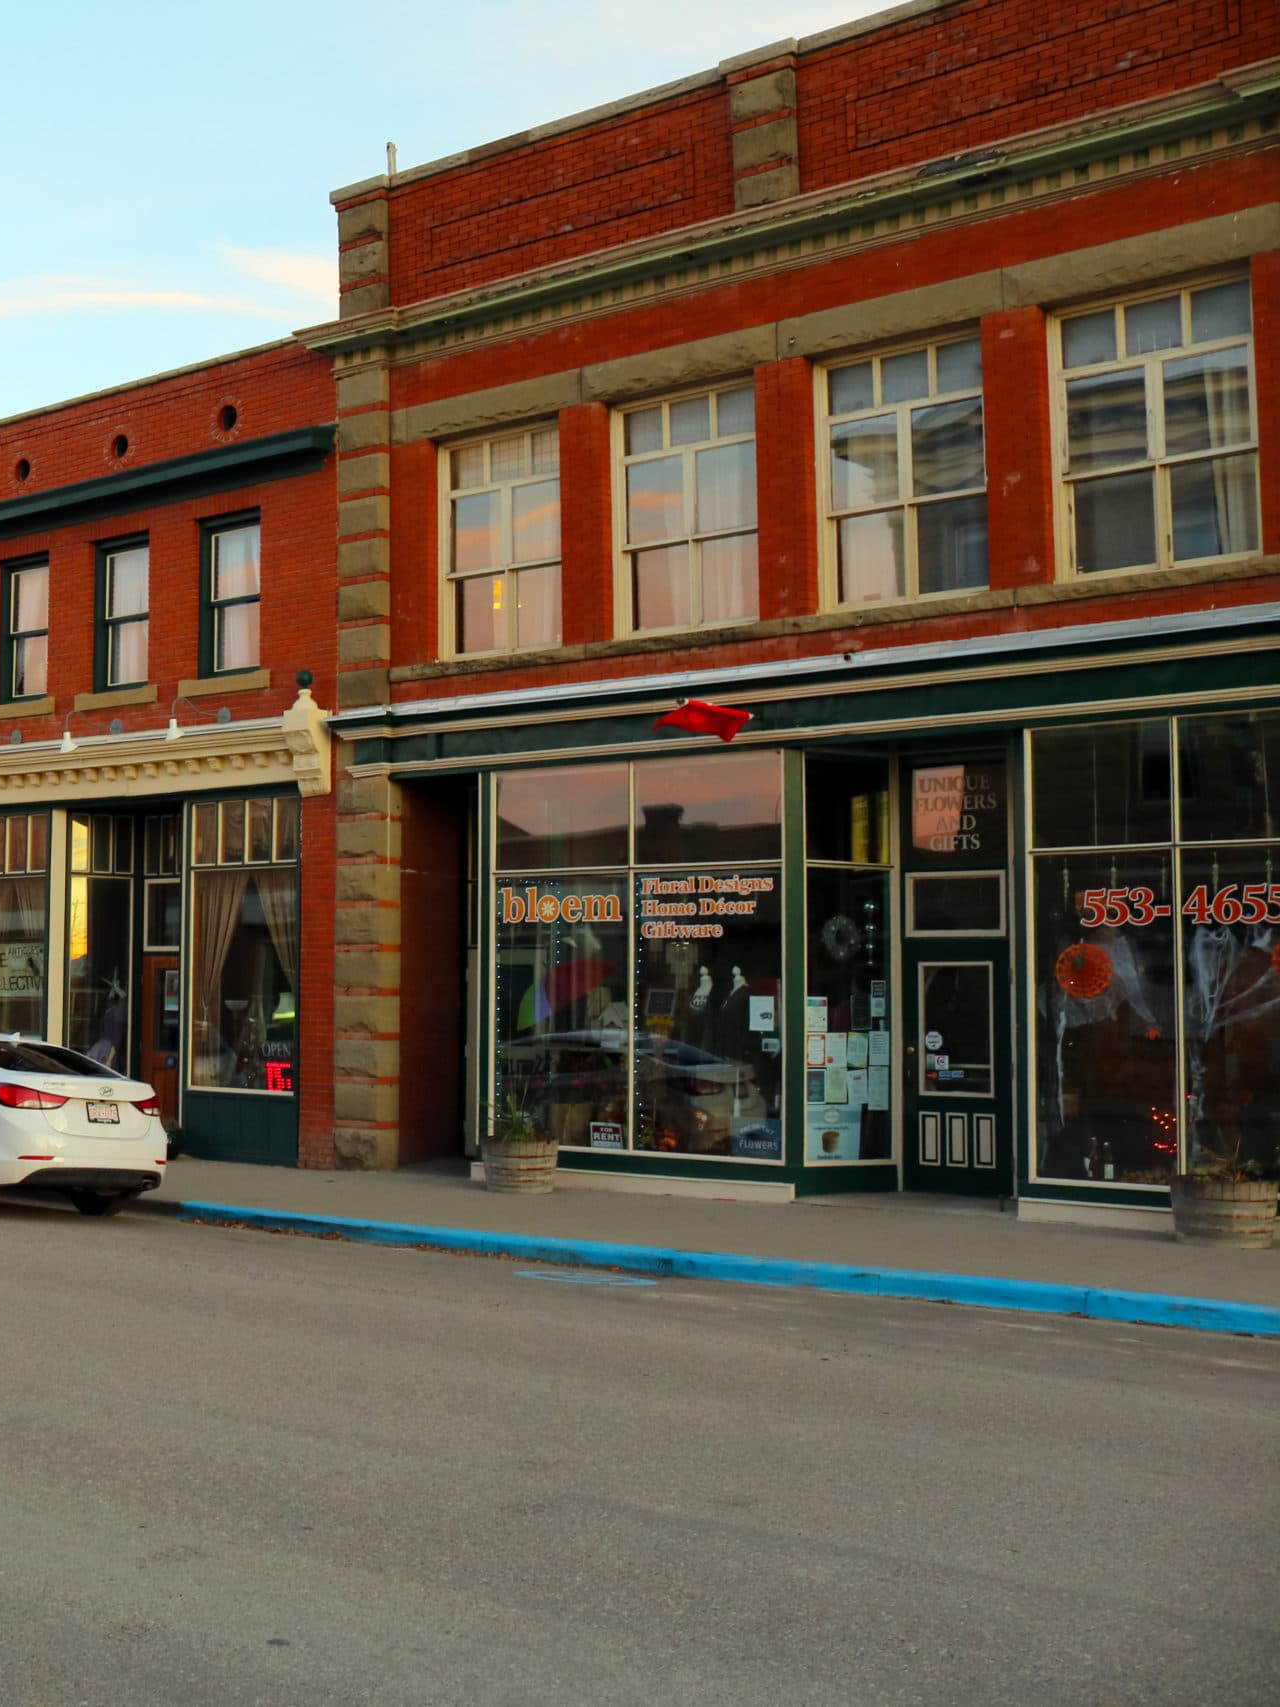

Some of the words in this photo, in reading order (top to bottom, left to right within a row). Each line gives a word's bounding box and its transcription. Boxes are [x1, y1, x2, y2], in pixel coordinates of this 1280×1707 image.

[918, 775, 990, 793] UNIQUE
[915, 792, 997, 812] FLOWERS
[936, 815, 977, 831] AND
[929, 833, 980, 851] GIFTS
[641, 877, 696, 895] Floral
[699, 876, 773, 895] Designs
[501, 887, 624, 924] bloem
[641, 900, 697, 917] Home
[699, 898, 756, 916] Décor
[641, 922, 723, 939] Giftware
[261, 1041, 292, 1057] OPEN
[593, 1132, 620, 1142] RENT
[738, 1138, 778, 1151] FLOWERS
